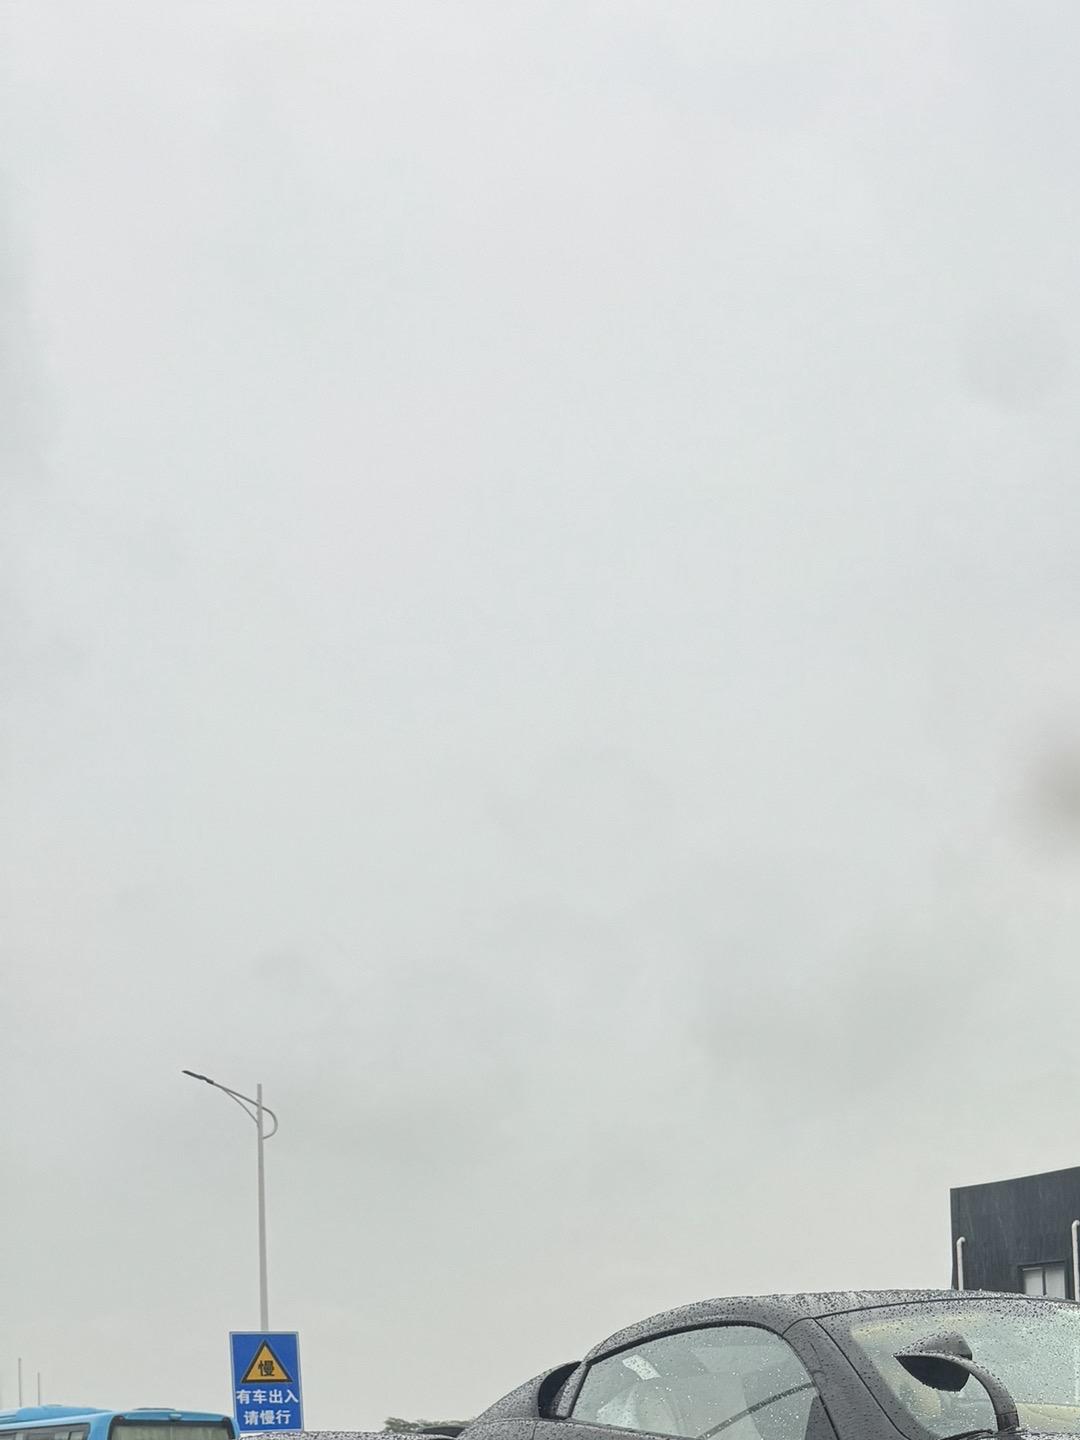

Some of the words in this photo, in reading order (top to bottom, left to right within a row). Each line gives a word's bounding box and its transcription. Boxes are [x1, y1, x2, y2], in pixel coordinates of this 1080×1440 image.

[258, 1360, 275, 1376] 慢
[236, 1389, 299, 1404] 有车出入
[243, 1409, 291, 1425] 请慢行
